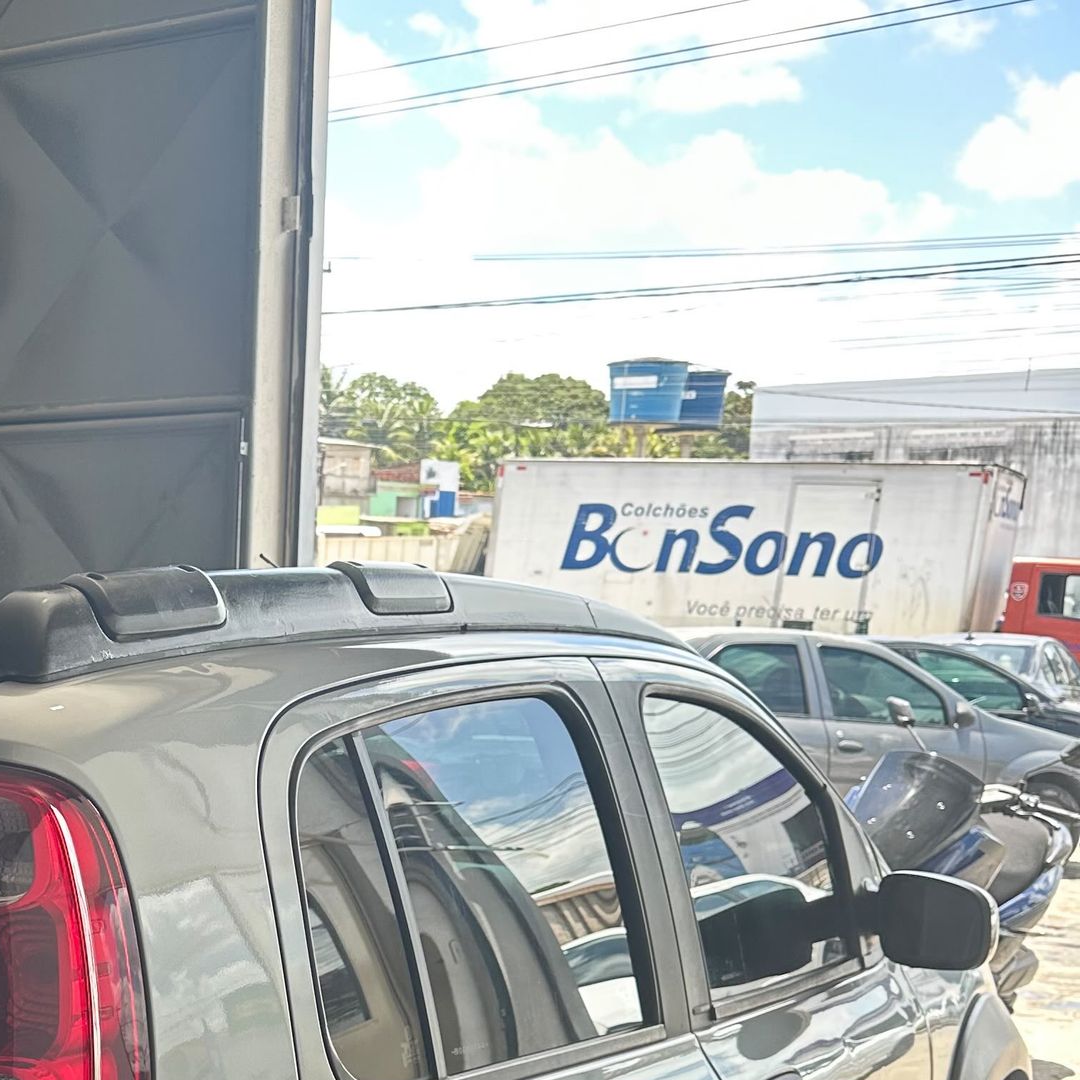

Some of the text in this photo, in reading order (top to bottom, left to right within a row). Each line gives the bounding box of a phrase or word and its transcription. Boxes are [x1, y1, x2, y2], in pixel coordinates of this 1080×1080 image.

[620, 503, 709, 518] Colchões
[686, 600, 730, 616] Você
[735, 604, 804, 620] precisa
[813, 606, 840, 621] ter
